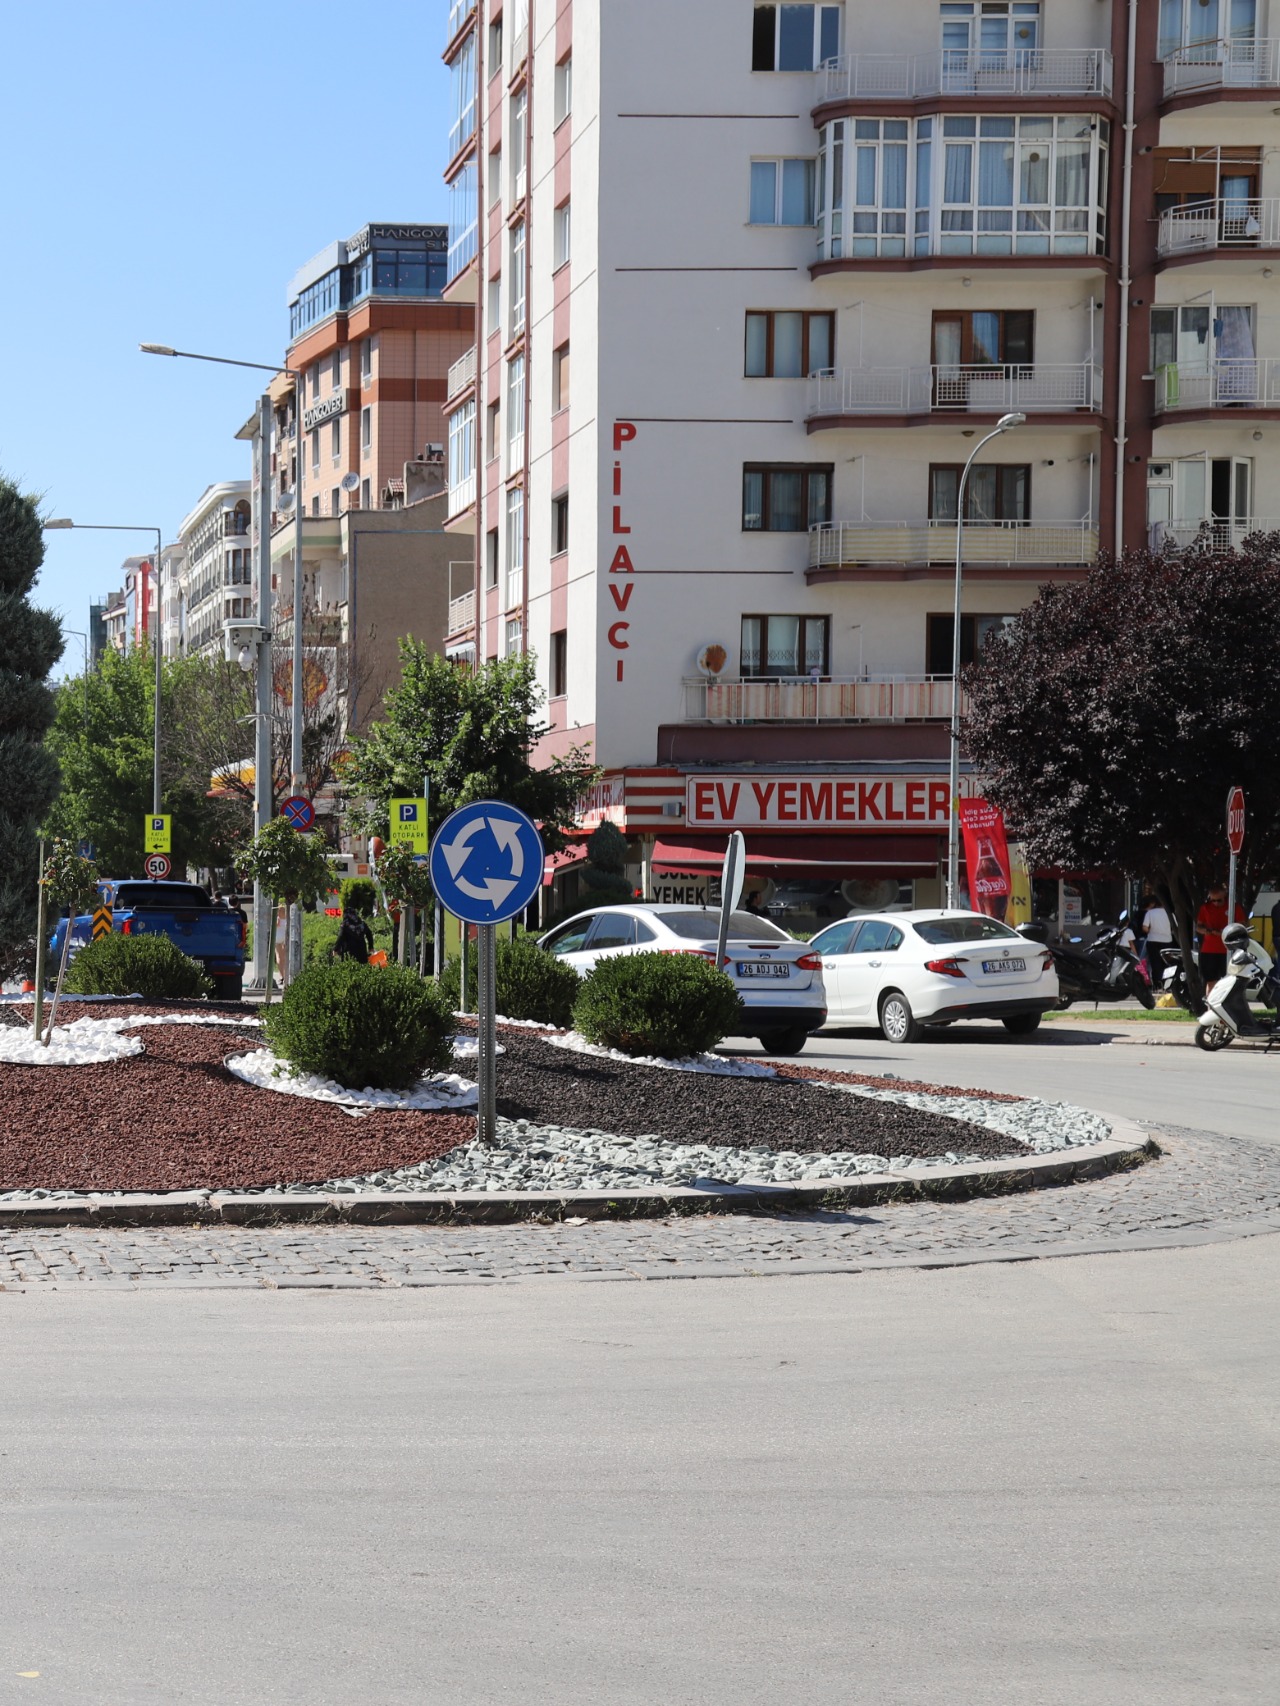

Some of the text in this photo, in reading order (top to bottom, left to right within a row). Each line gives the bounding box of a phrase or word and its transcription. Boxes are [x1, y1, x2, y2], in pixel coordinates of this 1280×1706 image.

[305, 396, 342, 427] HANGOVER
[608, 422, 637, 682] PİLAVCI
[695, 782, 961, 821] EV YEMEKLER
[1229, 809, 1244, 834] DUR
[150, 861, 166, 872] 50
[653, 886, 706, 904] YEMEK
[744, 964, 753, 974] 26
[774, 965, 788, 975] 042
